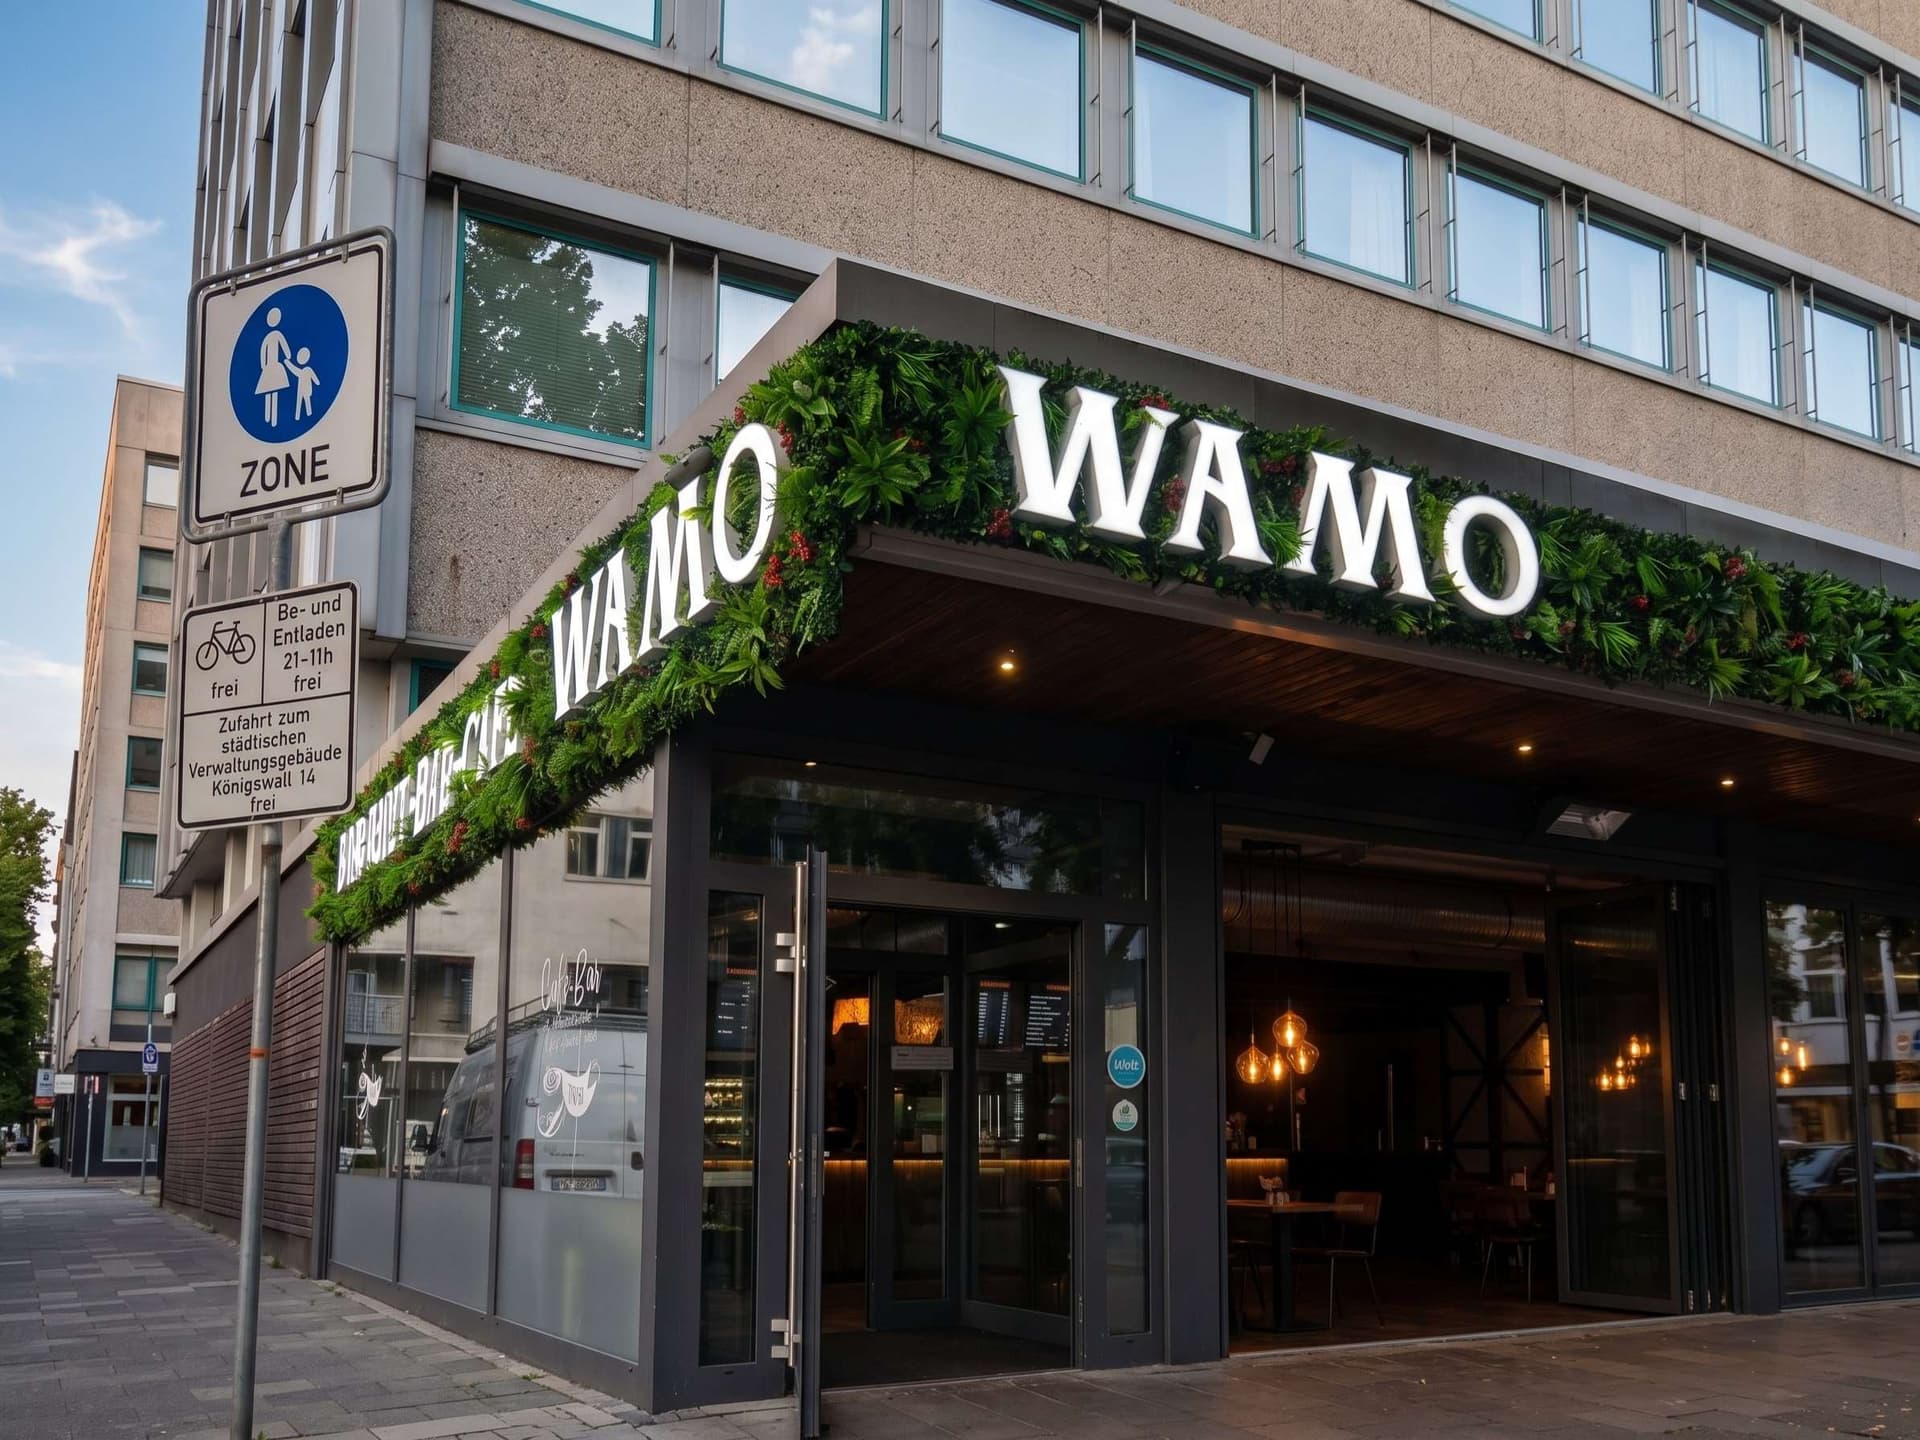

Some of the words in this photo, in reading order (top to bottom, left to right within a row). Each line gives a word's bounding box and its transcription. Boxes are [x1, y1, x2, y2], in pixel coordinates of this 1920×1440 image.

[240, 443, 330, 498] ZONE
[998, 364, 1540, 617] WAMO
[551, 422, 778, 721] WAMO
[278, 603, 306, 621] Be-
[311, 593, 341, 615] und
[274, 621, 345, 647] Entladen
[283, 646, 333, 670] 21-11h
[211, 679, 238, 699] frei
[294, 671, 321, 692] frei
[219, 712, 273, 734] Zufahrt
[278, 710, 310, 726] zum
[222, 730, 306, 753] städtischen
[188, 744, 342, 778] Verwaltungsgebäude
[213, 771, 292, 797] Königswall
[300, 767, 315, 785] 14
[250, 794, 276, 813] frei
[1114, 1059, 1140, 1071] Wolt
